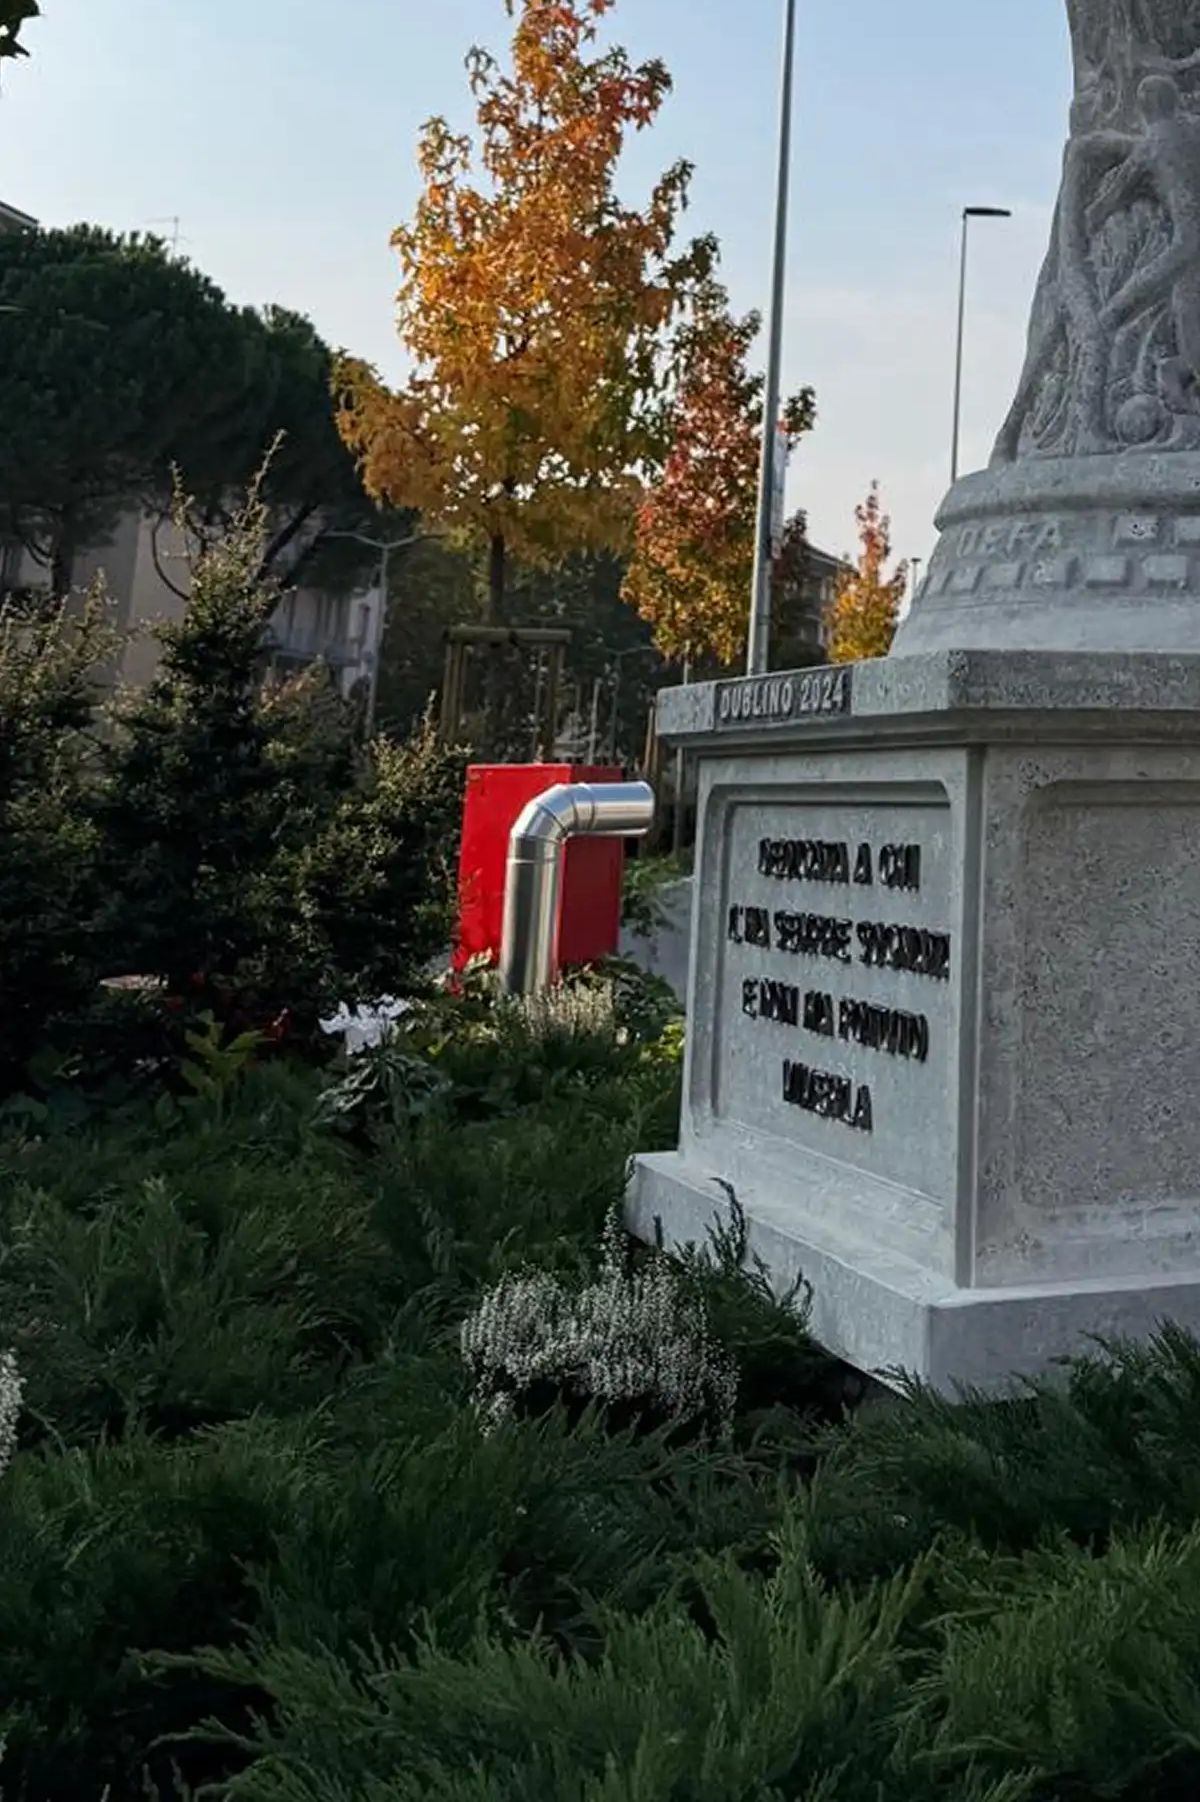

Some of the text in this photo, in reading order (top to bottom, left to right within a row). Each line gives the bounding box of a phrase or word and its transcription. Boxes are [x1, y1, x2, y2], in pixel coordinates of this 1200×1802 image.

[719, 670, 846, 719] DUBLINO 2024
[853, 841, 873, 886] A
[742, 978, 758, 1020] E
